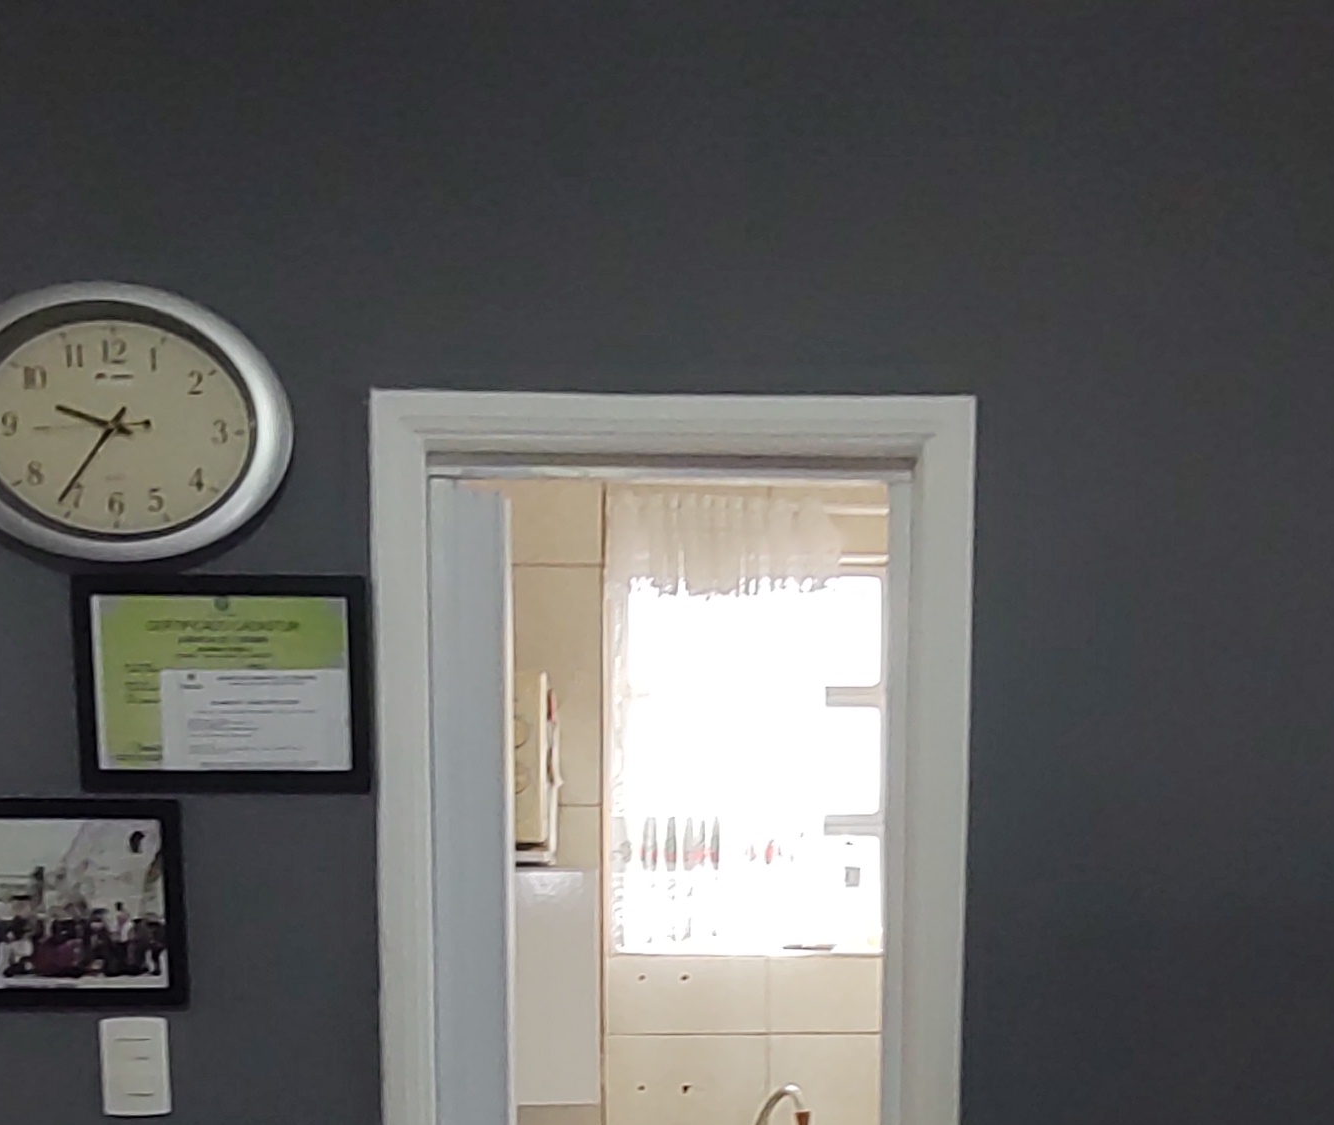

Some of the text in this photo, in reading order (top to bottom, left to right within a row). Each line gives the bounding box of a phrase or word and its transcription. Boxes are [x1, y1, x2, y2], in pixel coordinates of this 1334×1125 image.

[65, 343, 84, 368] 11
[101, 338, 128, 365] 12
[149, 346, 157, 372] 1
[22, 365, 48, 391] 10
[186, 369, 204, 395] 2
[0, 410, 18, 437] 9
[210, 418, 229, 445] 3
[26, 459, 45, 487] 8
[188, 466, 205, 493] 4
[69, 480, 85, 510] 7
[106, 491, 125, 517] 6
[148, 486, 165, 513] 5
